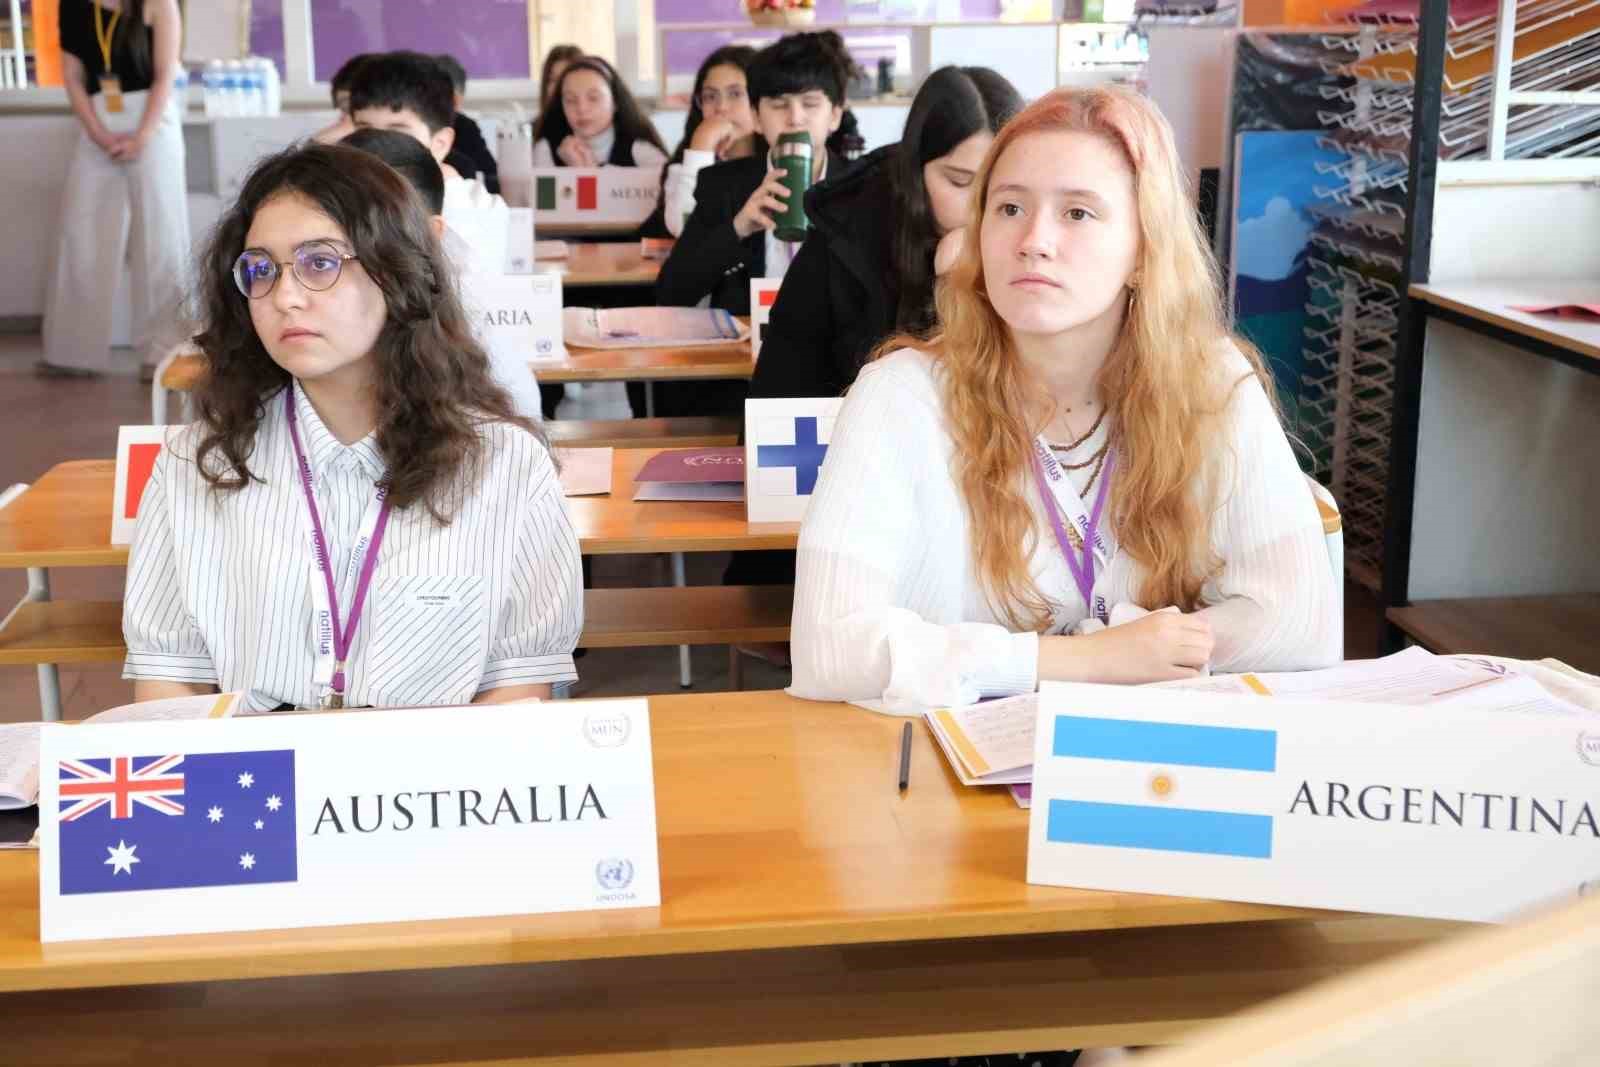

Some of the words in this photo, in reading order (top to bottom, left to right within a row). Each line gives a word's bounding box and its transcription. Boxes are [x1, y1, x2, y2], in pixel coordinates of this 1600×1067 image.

[483, 309, 533, 326] ARIA
[310, 783, 612, 836] AUSTRALIA
[1288, 780, 1600, 838] ARGENTINA
